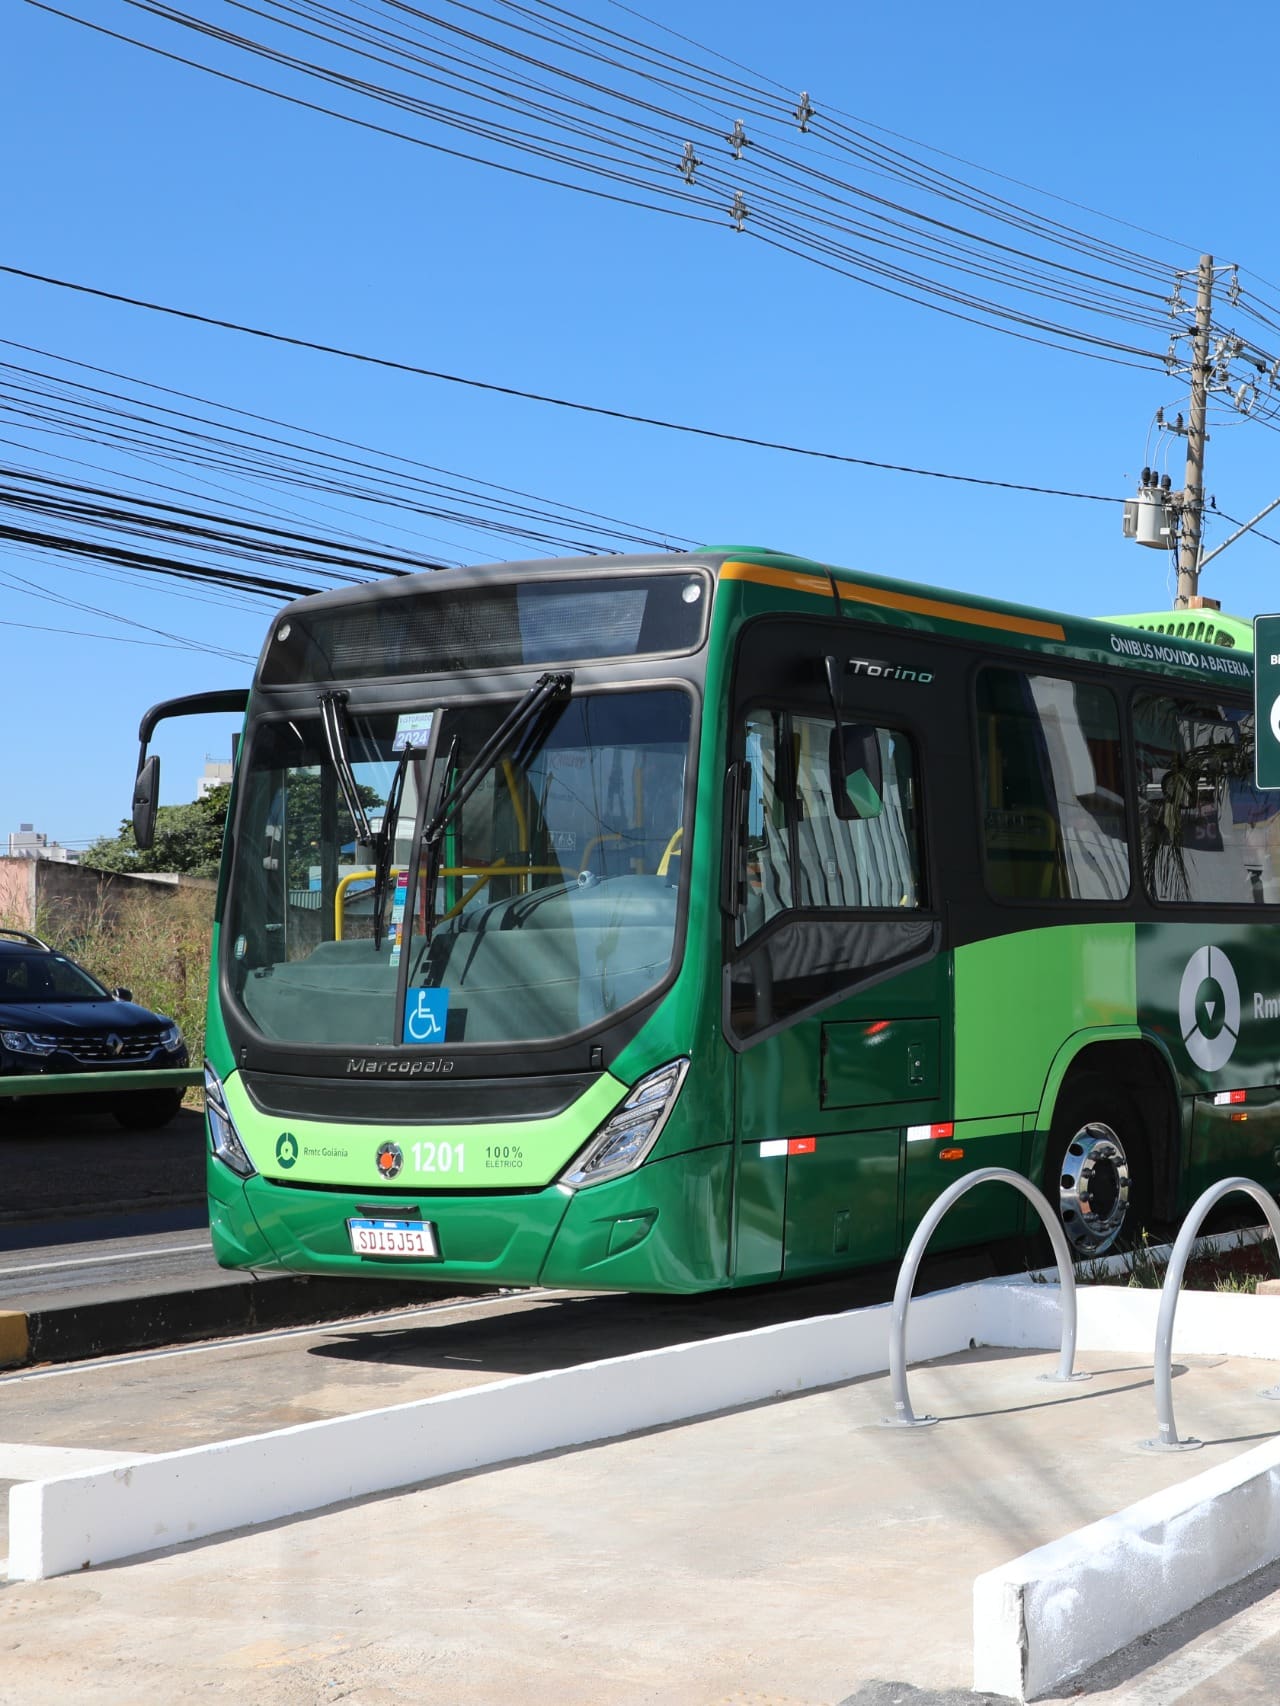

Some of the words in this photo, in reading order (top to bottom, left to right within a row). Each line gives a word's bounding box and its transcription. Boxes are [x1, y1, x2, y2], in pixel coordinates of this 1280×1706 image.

[1110, 633, 1154, 659] ÔNIBUS
[1154, 645, 1200, 668] MOVIDO
[1210, 656, 1251, 678] BATERIA
[849, 659, 933, 683] Torino
[396, 730, 428, 747] 2024
[346, 1058, 454, 1076] Marcopolo
[303, 1146, 321, 1157] Rmtc
[322, 1147, 348, 1157] Goiânia
[411, 1141, 465, 1173] 1201
[486, 1146, 523, 1159] 100%
[359, 1231, 425, 1252] SDI5J51
